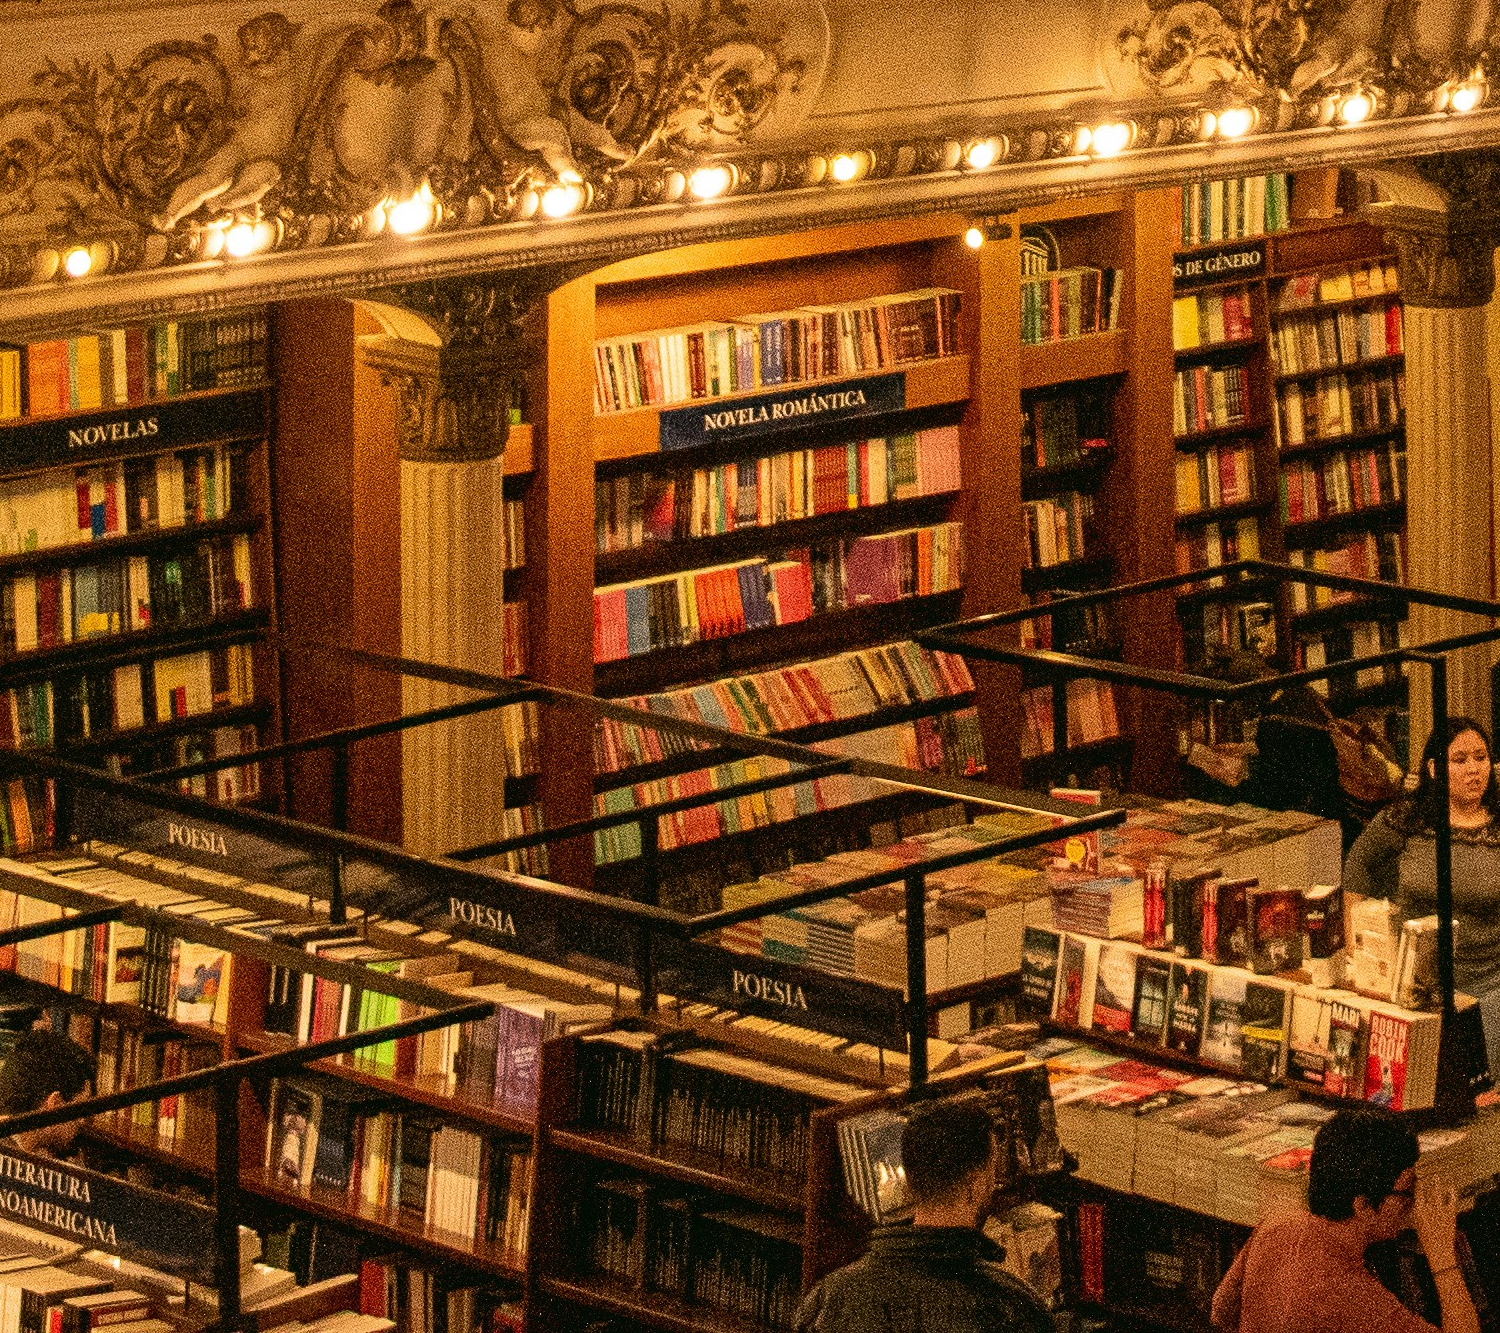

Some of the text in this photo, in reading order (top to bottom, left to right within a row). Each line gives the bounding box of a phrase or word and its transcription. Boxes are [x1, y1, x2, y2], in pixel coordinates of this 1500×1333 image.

[1185, 259, 1204, 276] DE
[1204, 250, 1262, 273] GÉNERO
[702, 389, 867, 432] NOVELA ROMÁNTICA
[68, 417, 160, 448] NOVELAS
[168, 822, 229, 858] POESIA
[449, 896, 518, 937] POESIA
[732, 969, 809, 1012] POESIA
[1369, 1033, 1405, 1065] COOK
